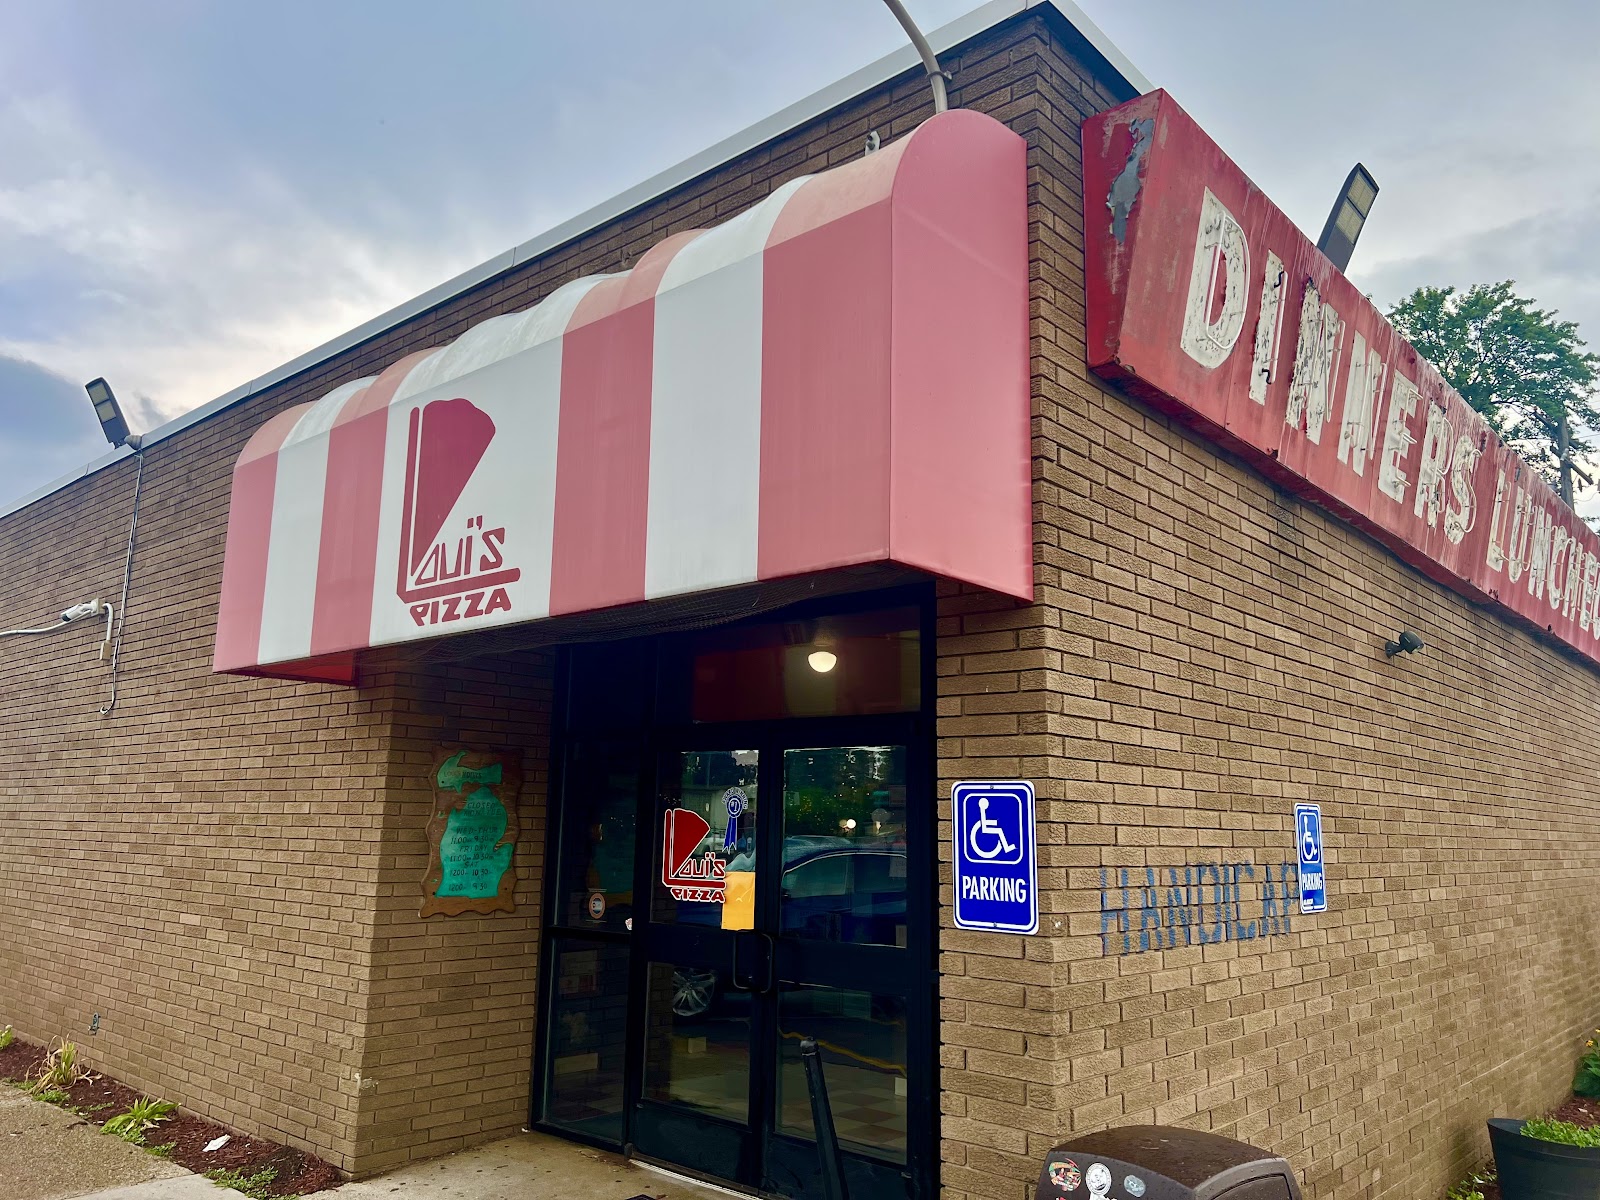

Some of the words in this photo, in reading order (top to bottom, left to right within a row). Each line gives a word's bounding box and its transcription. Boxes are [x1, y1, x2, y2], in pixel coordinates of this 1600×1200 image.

[1180, 186, 1484, 546] DINNERS
[409, 587, 512, 627] PIZZA
[467, 801, 496, 810] CLOSED
[464, 861, 479, 869] SAT
[961, 875, 1028, 904] PARKING
[1302, 872, 1323, 891] PARKING
[670, 887, 726, 903] PIZZA
